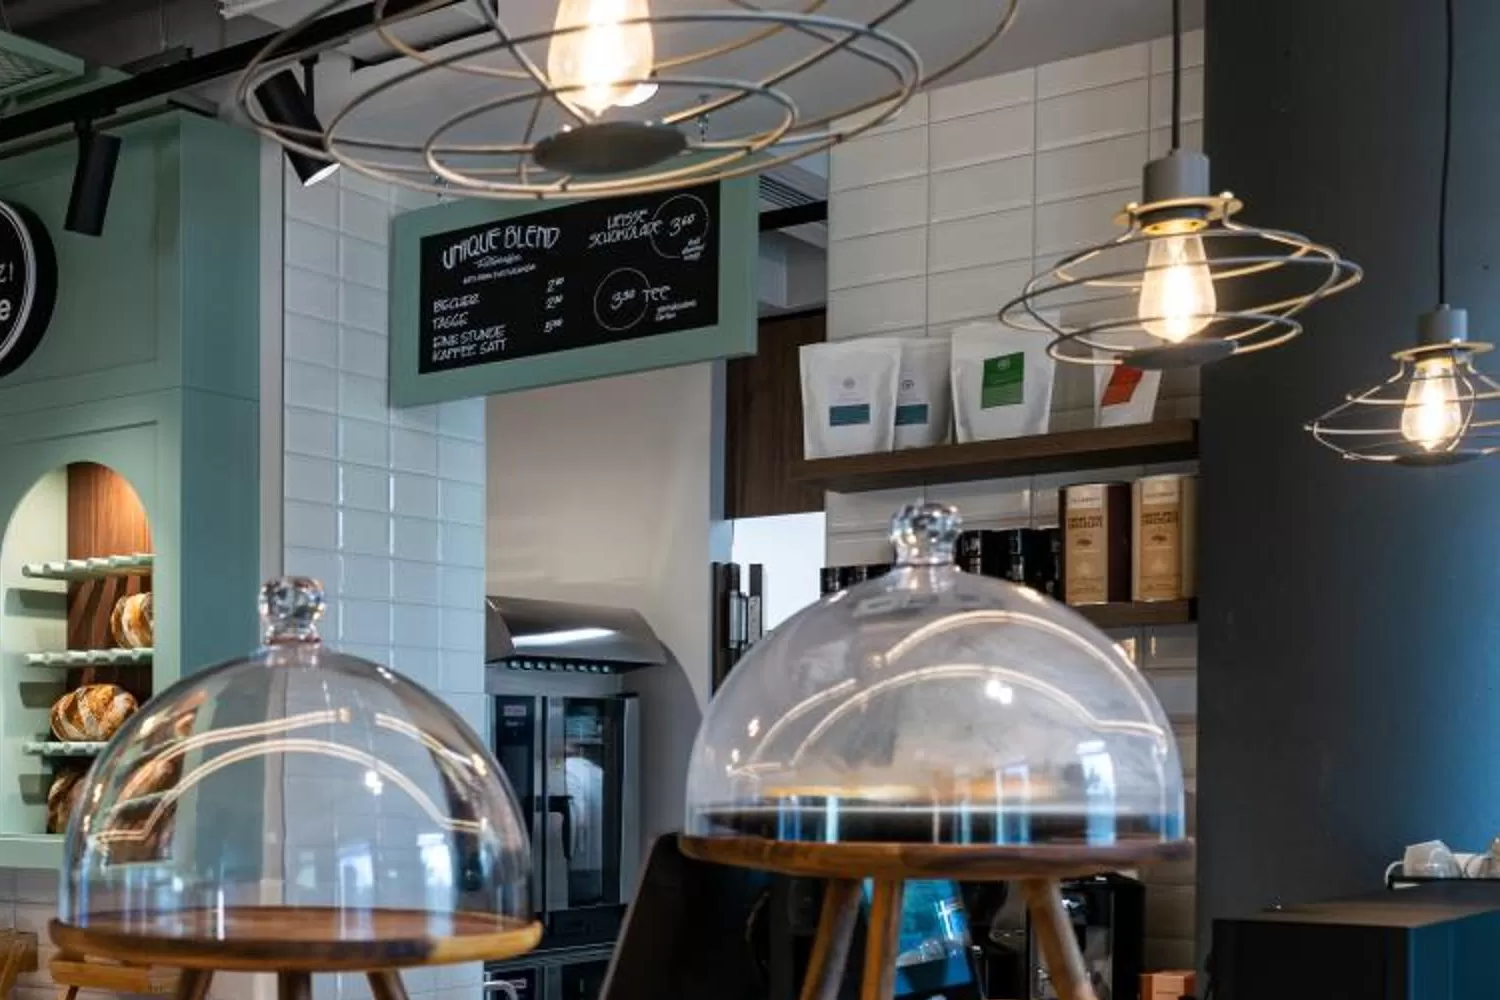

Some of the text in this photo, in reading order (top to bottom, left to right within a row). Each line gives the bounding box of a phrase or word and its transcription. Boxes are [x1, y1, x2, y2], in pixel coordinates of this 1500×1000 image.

[443, 227, 502, 269] UNIQUE
[504, 224, 561, 249] BLEND
[642, 285, 671, 302] TEE
[480, 339, 507, 355] SATT
